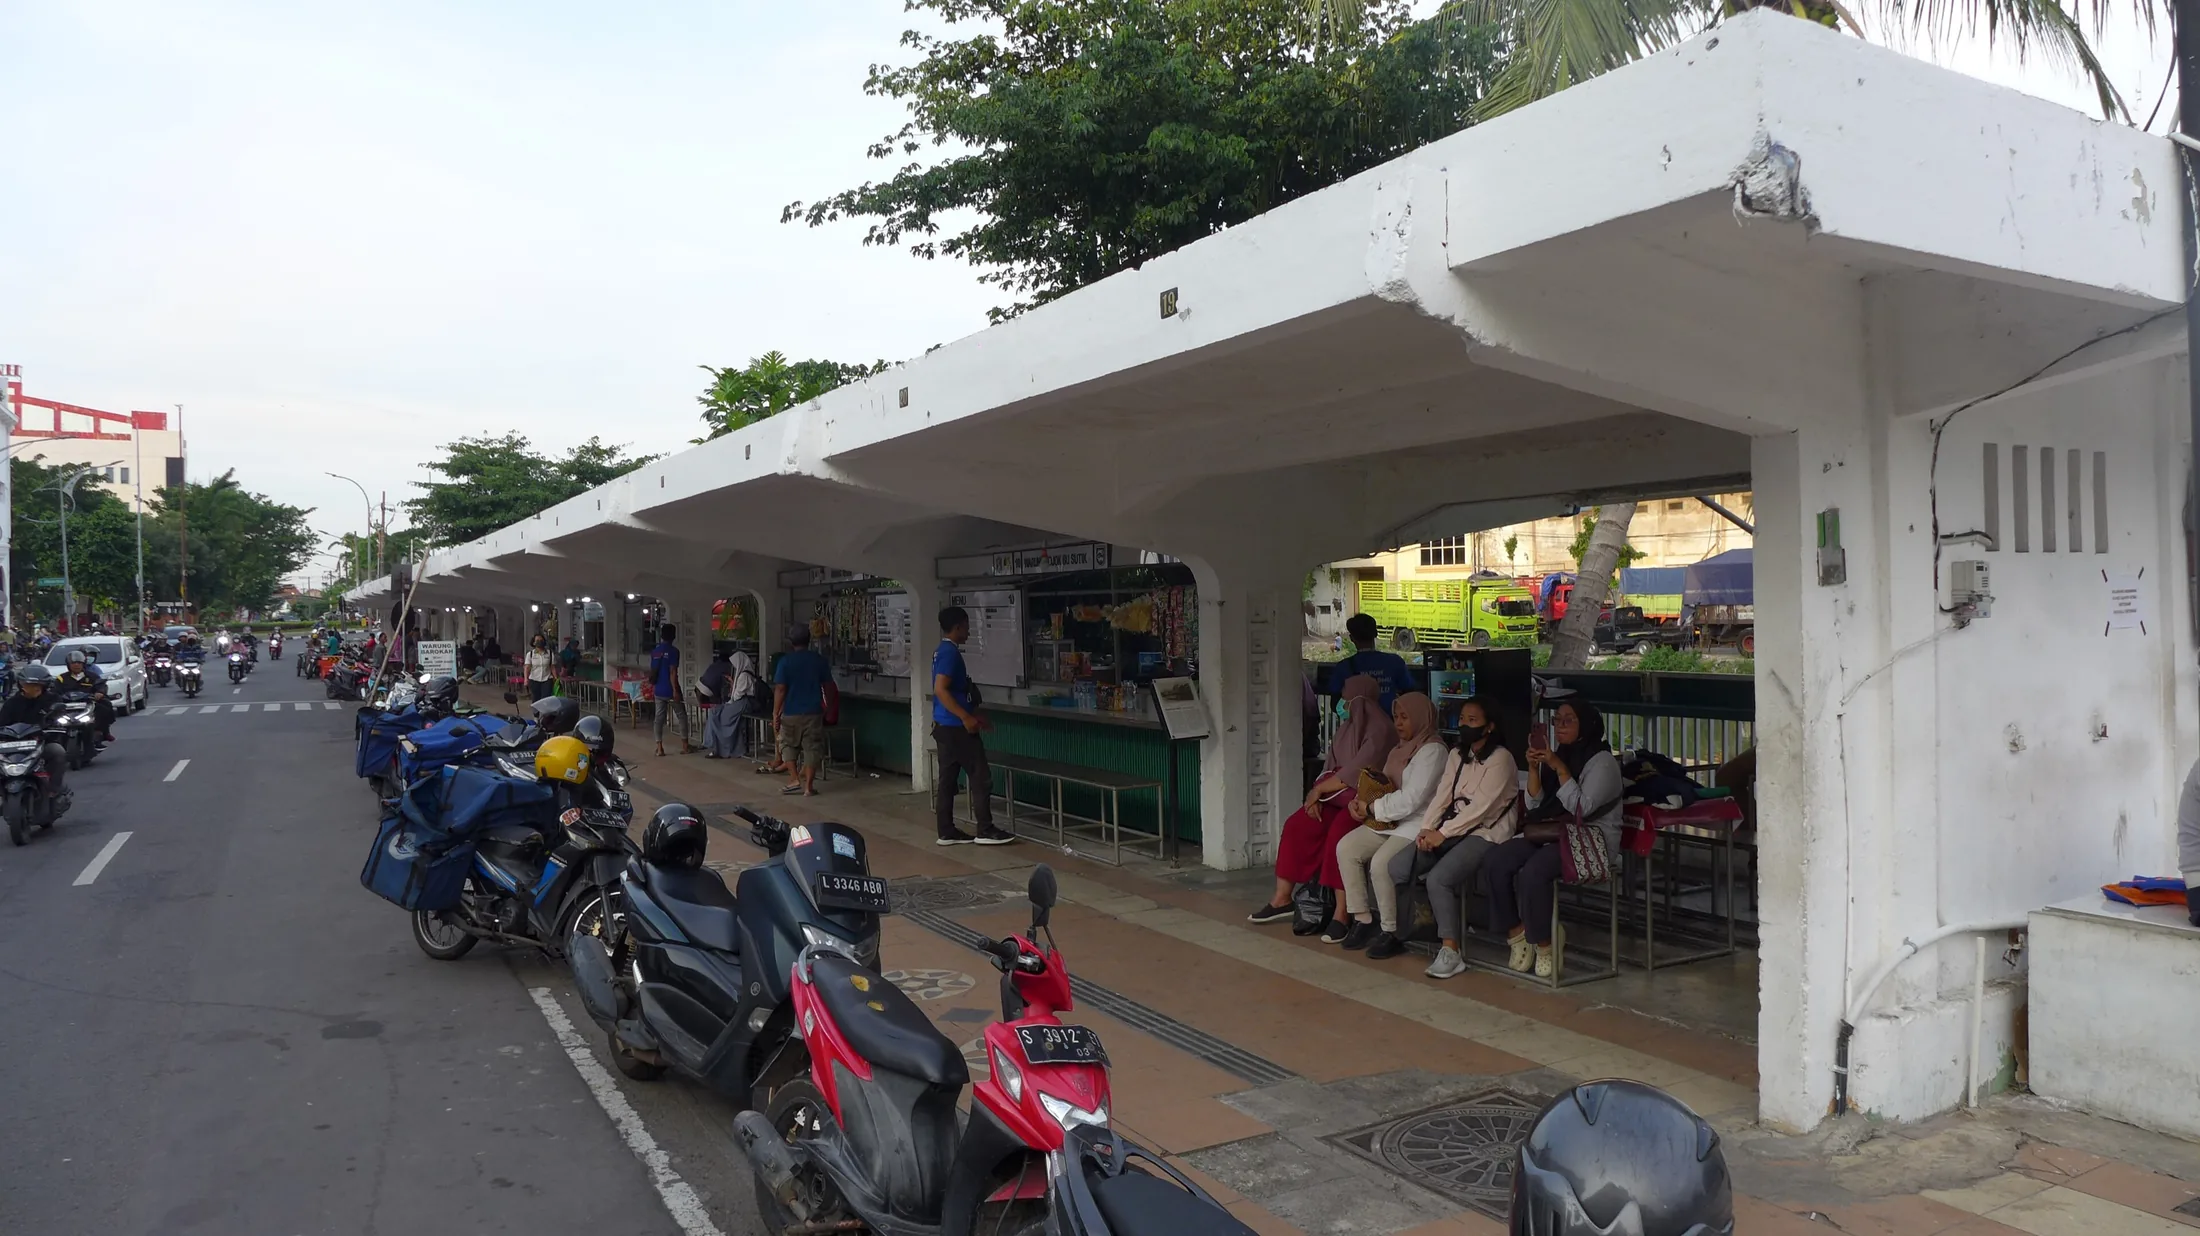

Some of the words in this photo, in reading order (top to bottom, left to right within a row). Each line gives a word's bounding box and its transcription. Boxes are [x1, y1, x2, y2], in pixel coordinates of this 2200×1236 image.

[1162, 291, 1176, 316] 19
[822, 876, 830, 889] L
[833, 877, 860, 891] 3346
[1022, 1030, 1033, 1044] S
[1043, 1028, 1079, 1043] 3912
[1076, 1047, 1090, 1056] 03
